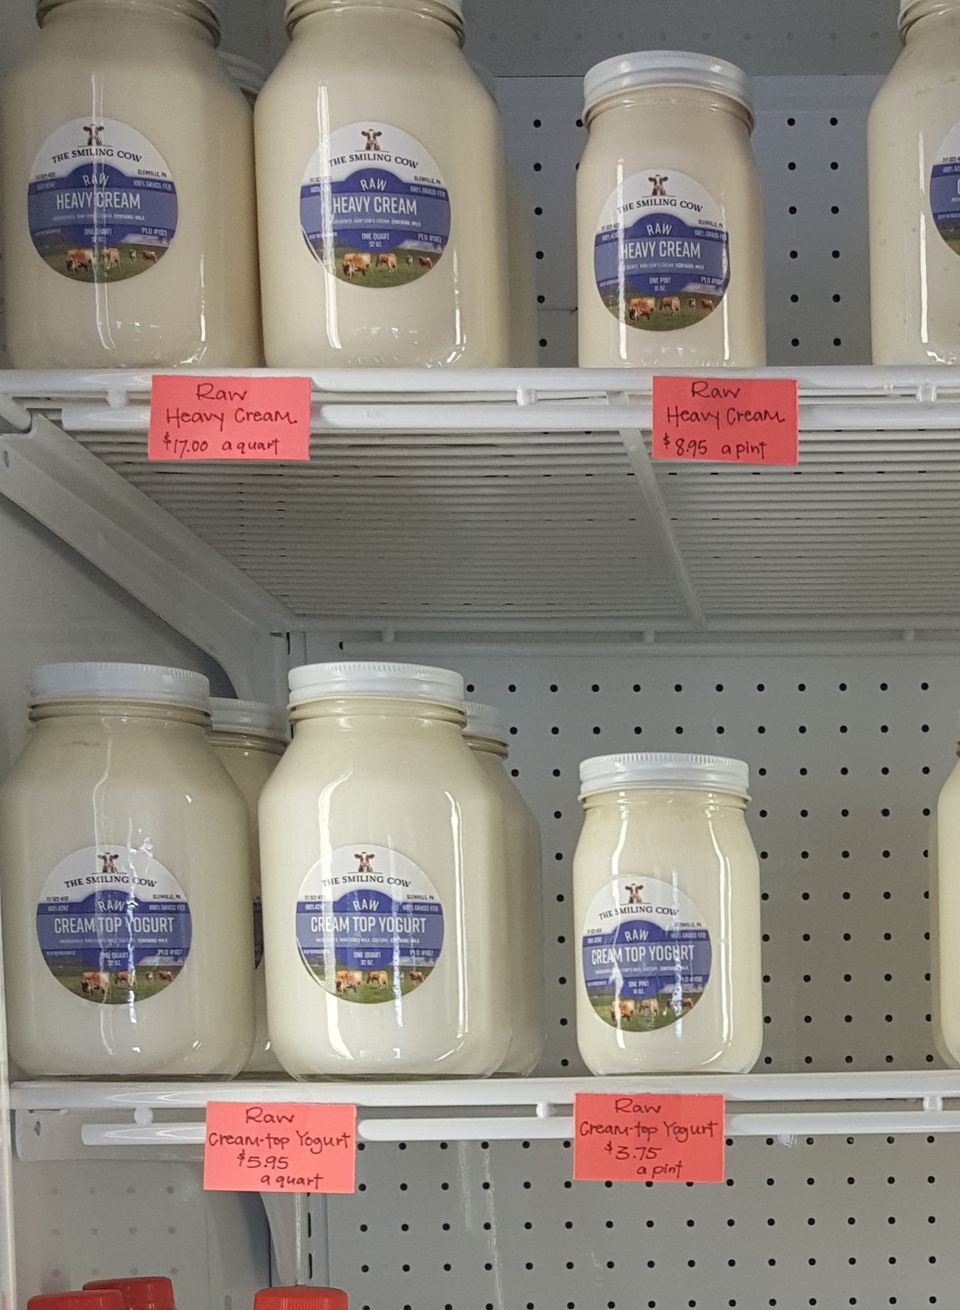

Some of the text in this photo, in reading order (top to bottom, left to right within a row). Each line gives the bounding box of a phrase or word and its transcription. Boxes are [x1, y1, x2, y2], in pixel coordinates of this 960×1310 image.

[56, 192, 141, 210] HEAVY CREAM
[333, 197, 417, 215] HEAVY CREAM
[623, 241, 701, 259] HEAVY CREAM
[196, 383, 247, 400] Raw
[691, 381, 740, 398] Raw
[167, 408, 297, 432] Heavy Cream
[667, 406, 785, 429] Heavy Cream
[163, 432, 280, 458] $17.00 a quart
[663, 433, 766, 459] $8.95 a pint
[55, 917, 174, 933] CREAM TOP YOGURT
[311, 916, 426, 933] CREAM TOP YOGURT
[592, 945, 694, 965] CREAM TOP YOGURT
[615, 1098, 661, 1113] Raw
[246, 1107, 294, 1123] Raw
[664, 1121, 718, 1143] Yogurt
[296, 1130, 350, 1154] Yogurt
[604, 1141, 662, 1160] $3.75
[237, 1149, 288, 1169] $5.95
[637, 1161, 683, 1178] a pint
[261, 1174, 323, 1189] a quart
